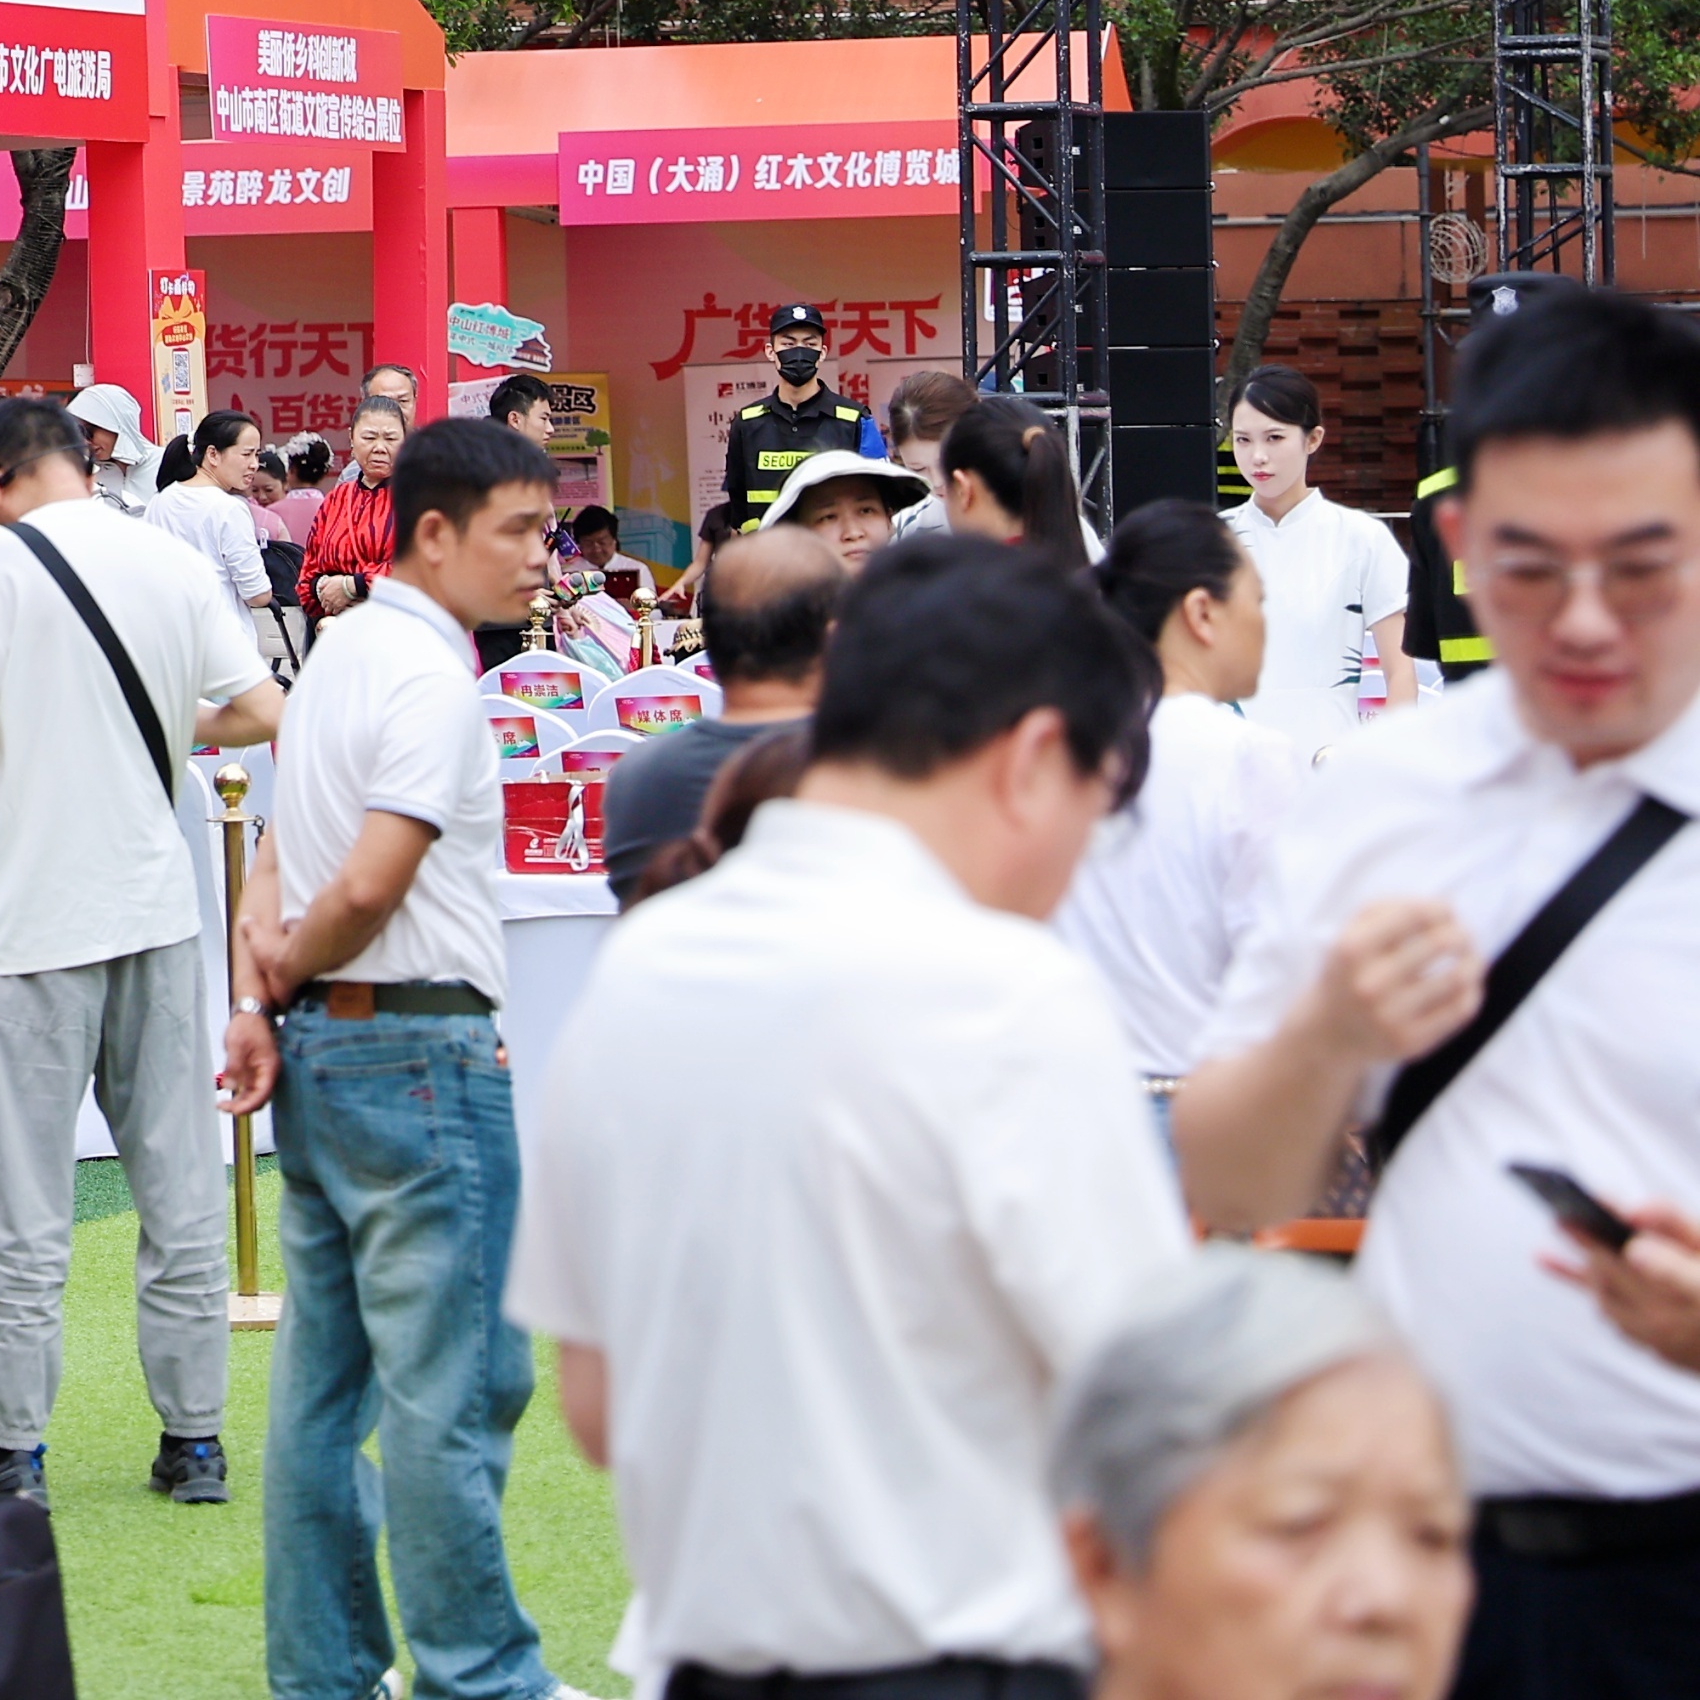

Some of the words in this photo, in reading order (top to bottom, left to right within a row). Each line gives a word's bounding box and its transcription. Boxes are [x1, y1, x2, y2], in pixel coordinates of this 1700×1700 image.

[257, 30, 357, 83] 美丽侨乡科创新城
[216, 84, 403, 143] 中山市南区街道文旅宣传综合展位
[181, 166, 350, 207] 景苑醉龙文创
[577, 148, 961, 196] 中国（大涌）红木文化博览城
[550, 385, 597, 413] 景区
[637, 709, 683, 724] 媒体席
[494, 731, 517, 745] 席
